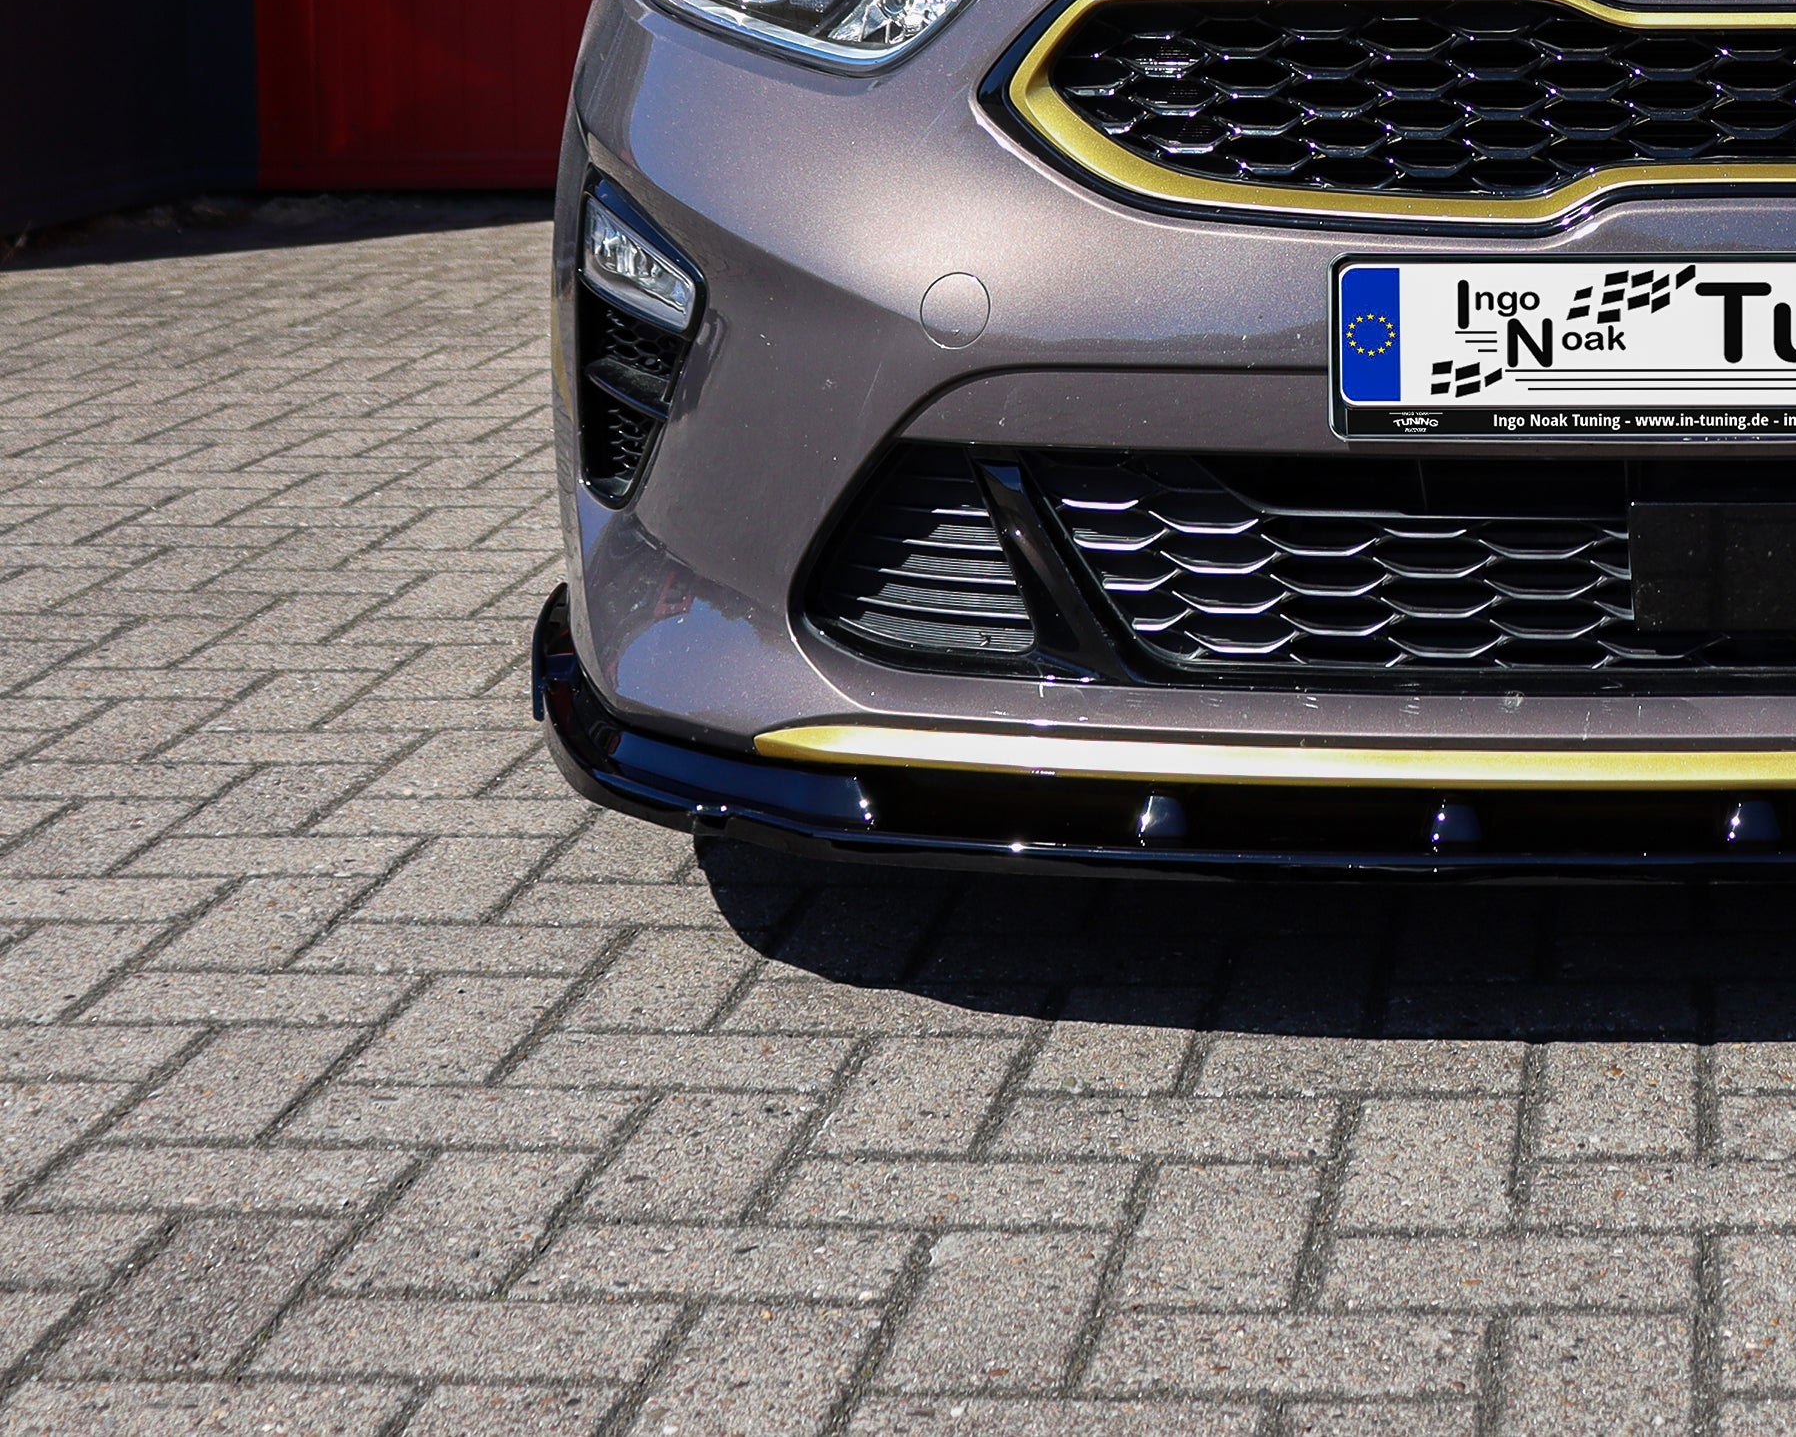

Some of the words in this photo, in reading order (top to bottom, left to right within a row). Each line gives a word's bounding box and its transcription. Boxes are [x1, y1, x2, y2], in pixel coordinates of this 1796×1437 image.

[1457, 279, 1541, 330] Ingo
[1507, 318, 1627, 368] Noak
[1393, 417, 1439, 427] TUNING
[1493, 413, 1526, 429] Ingo
[1530, 413, 1569, 427] Noak
[1572, 413, 1621, 429] Tuning
[1634, 413, 1769, 429] www.in-tuning.de
